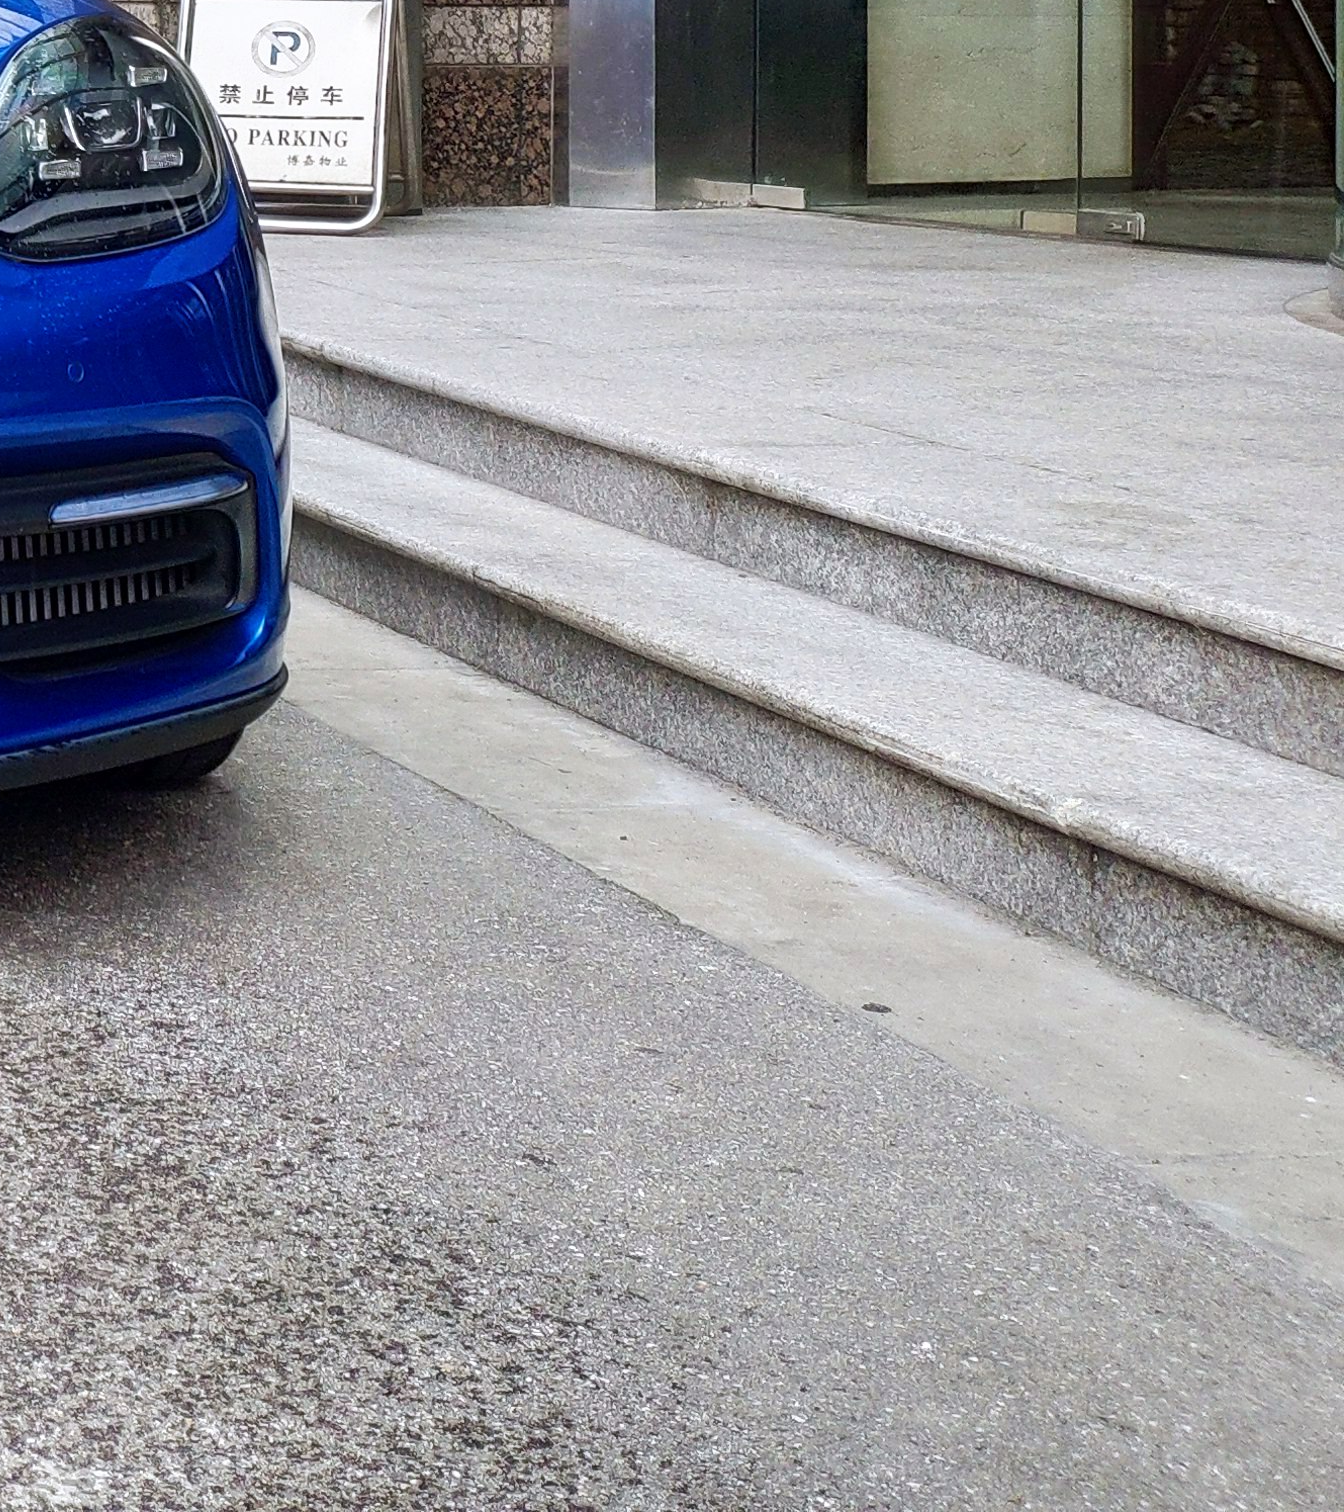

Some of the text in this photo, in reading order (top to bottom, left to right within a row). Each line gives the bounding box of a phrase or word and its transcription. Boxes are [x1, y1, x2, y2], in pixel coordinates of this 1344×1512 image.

[219, 84, 343, 106] 禁止停车
[248, 128, 349, 148] PARKING
